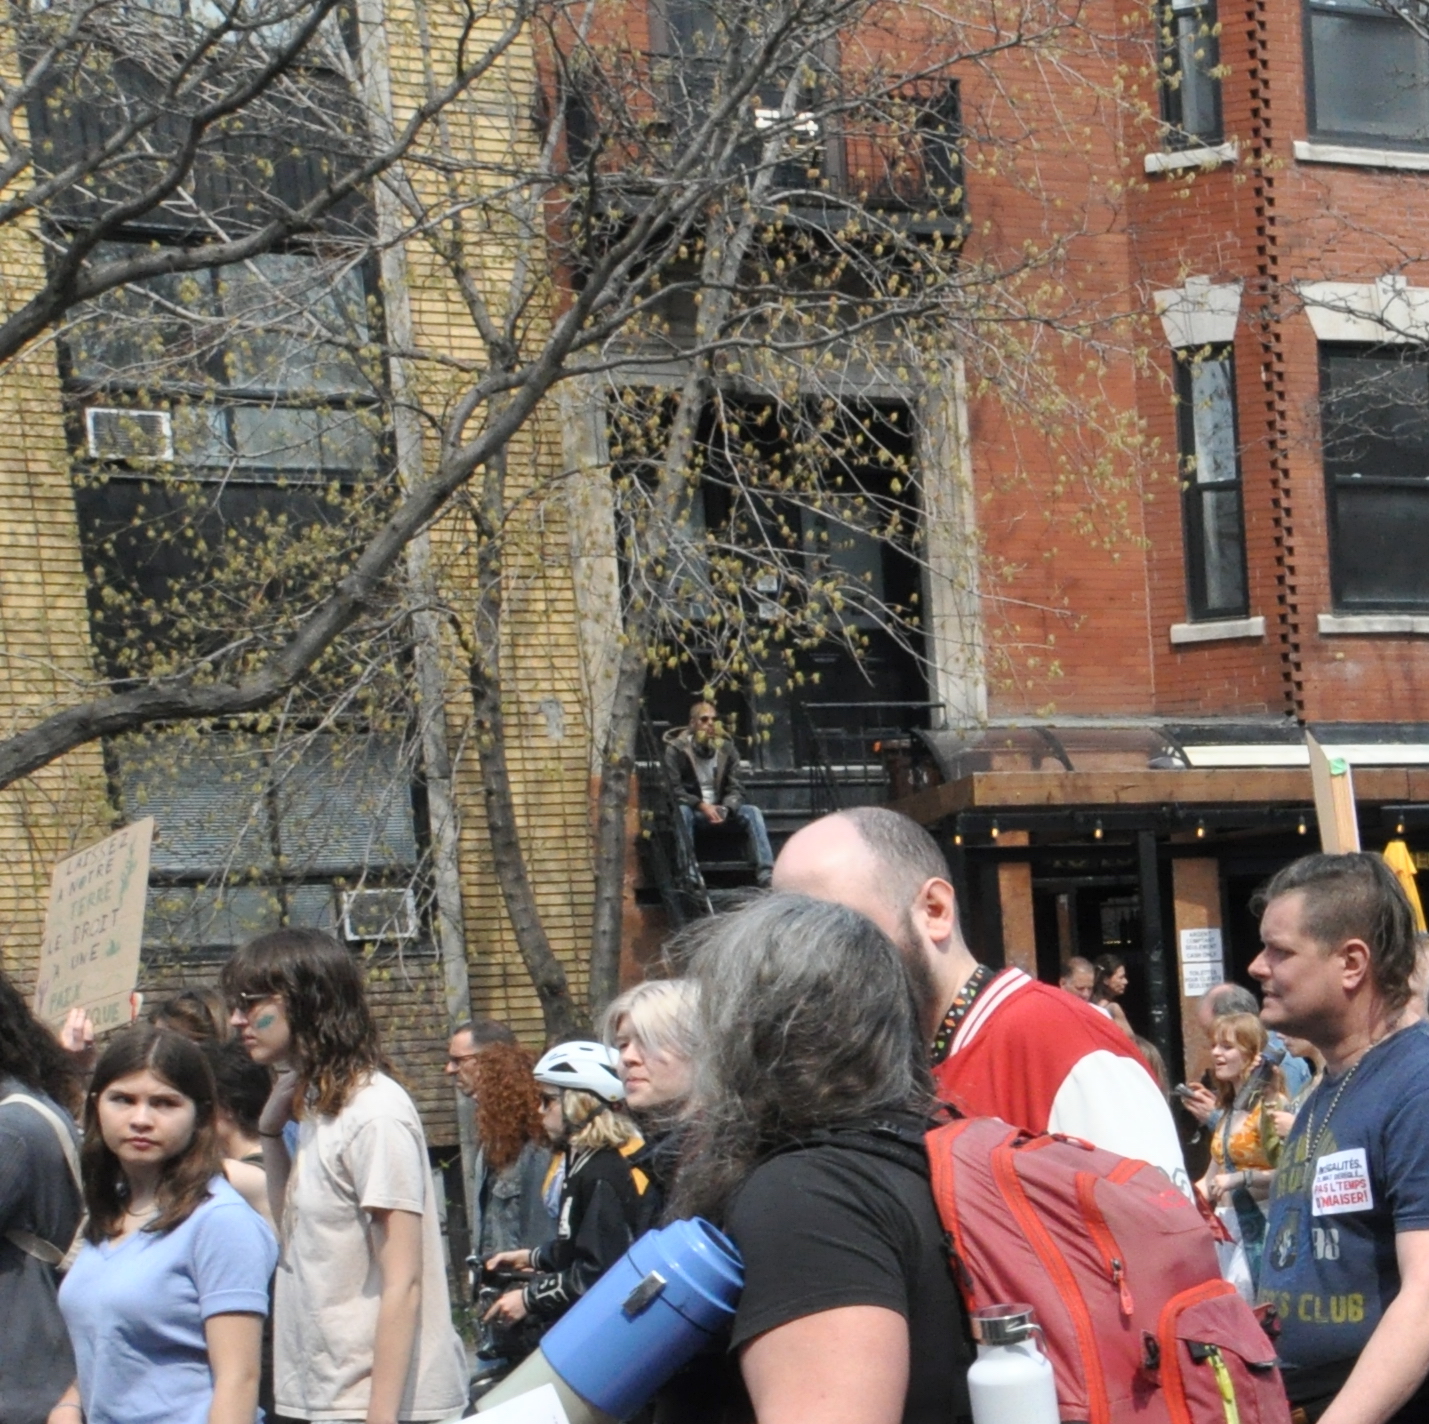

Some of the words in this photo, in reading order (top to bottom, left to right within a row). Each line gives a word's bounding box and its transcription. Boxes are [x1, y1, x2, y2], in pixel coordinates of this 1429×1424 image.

[66, 832, 129, 877] LAISSEZ
[68, 858, 114, 897] NOTRE
[70, 880, 113, 920] TERRE
[47, 934, 62, 956] LE
[72, 908, 120, 945] DROIT
[71, 942, 99, 970] UNE
[1314, 1183, 1328, 1194] PAS
[1298, 1293, 1364, 1324] CLUB
